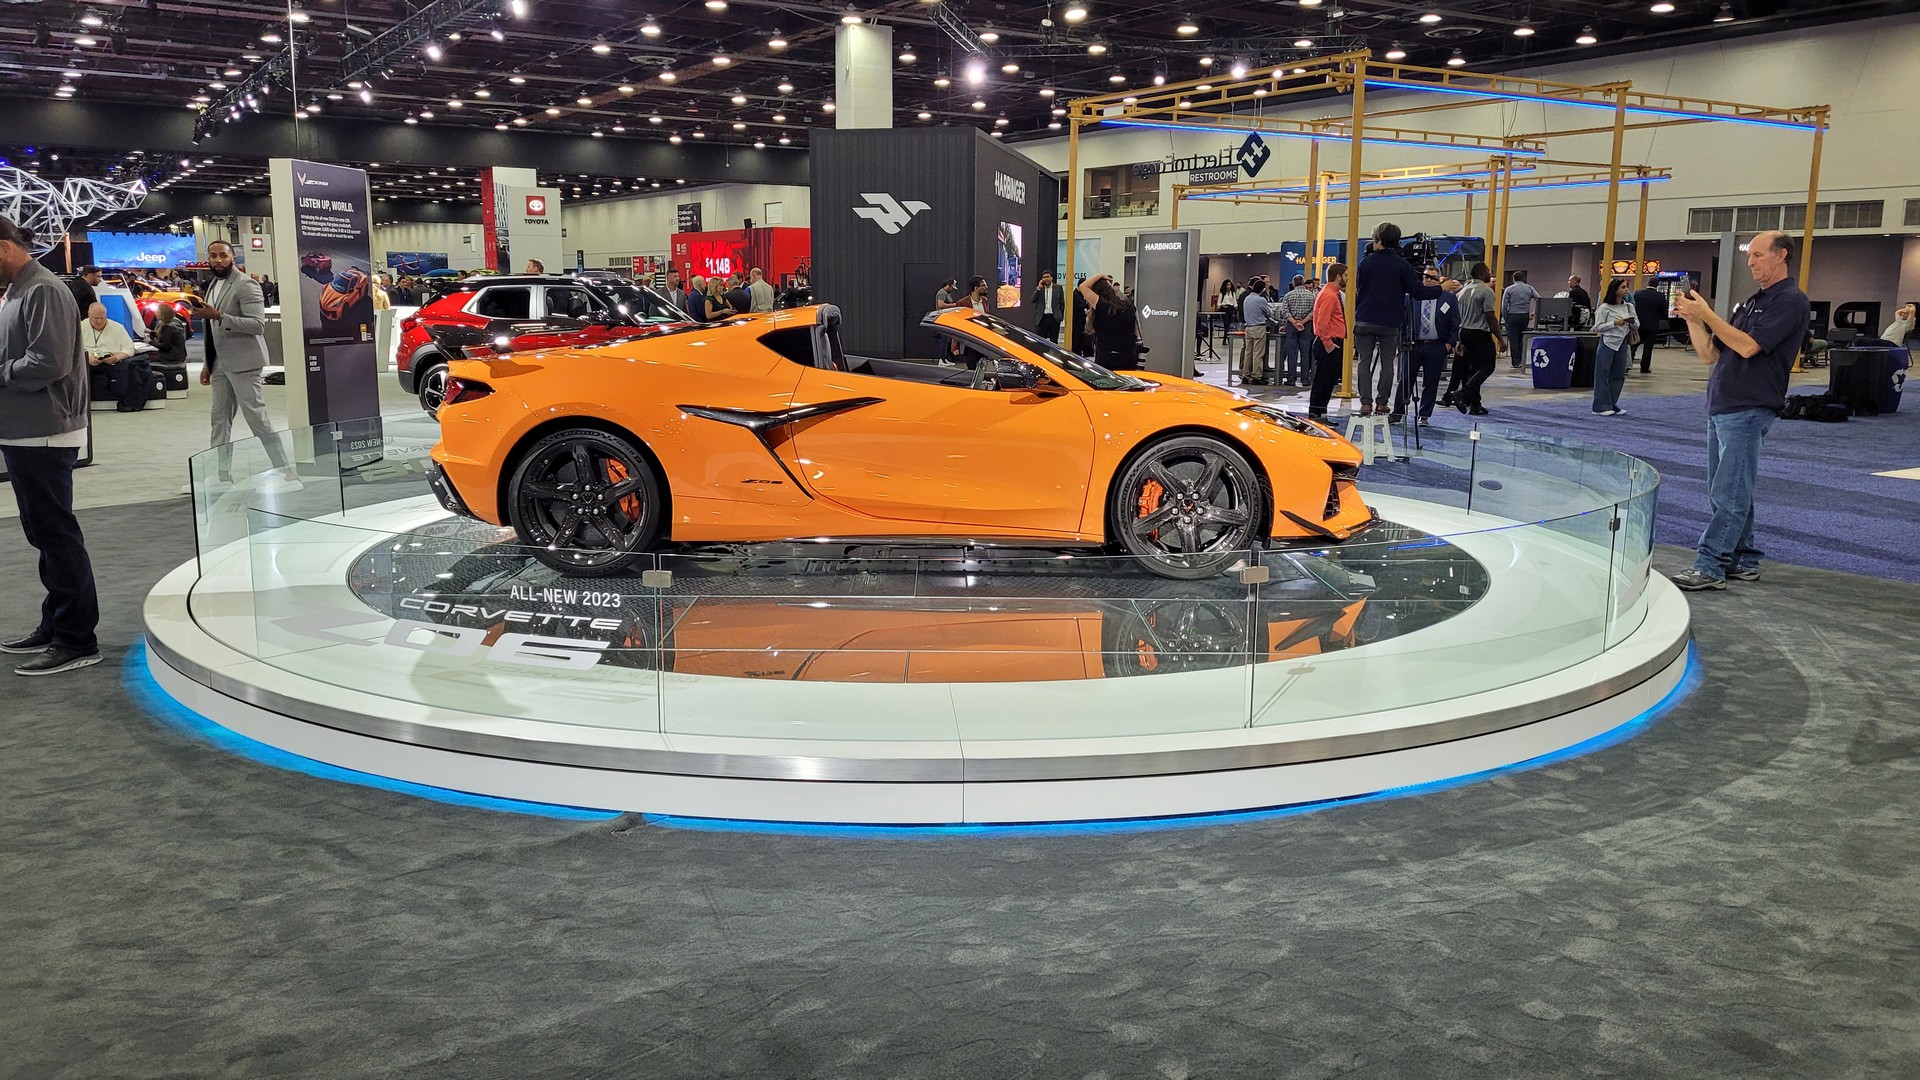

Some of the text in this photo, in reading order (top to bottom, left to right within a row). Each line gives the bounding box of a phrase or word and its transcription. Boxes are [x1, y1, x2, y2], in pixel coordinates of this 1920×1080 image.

[1189, 169, 1238, 183] RESTROOMS
[994, 170, 1026, 206] HARBINGER
[299, 197, 354, 212] LISTEN UP, WORLD.
[1144, 242, 1182, 251] HARBINGER
[136, 252, 166, 264] Jeep
[705, 257, 730, 274] $1.14B
[1151, 309, 1178, 318] ElectroForge
[510, 585, 621, 609] ALL-NEW 2023
[399, 597, 623, 631] CORVETTE
